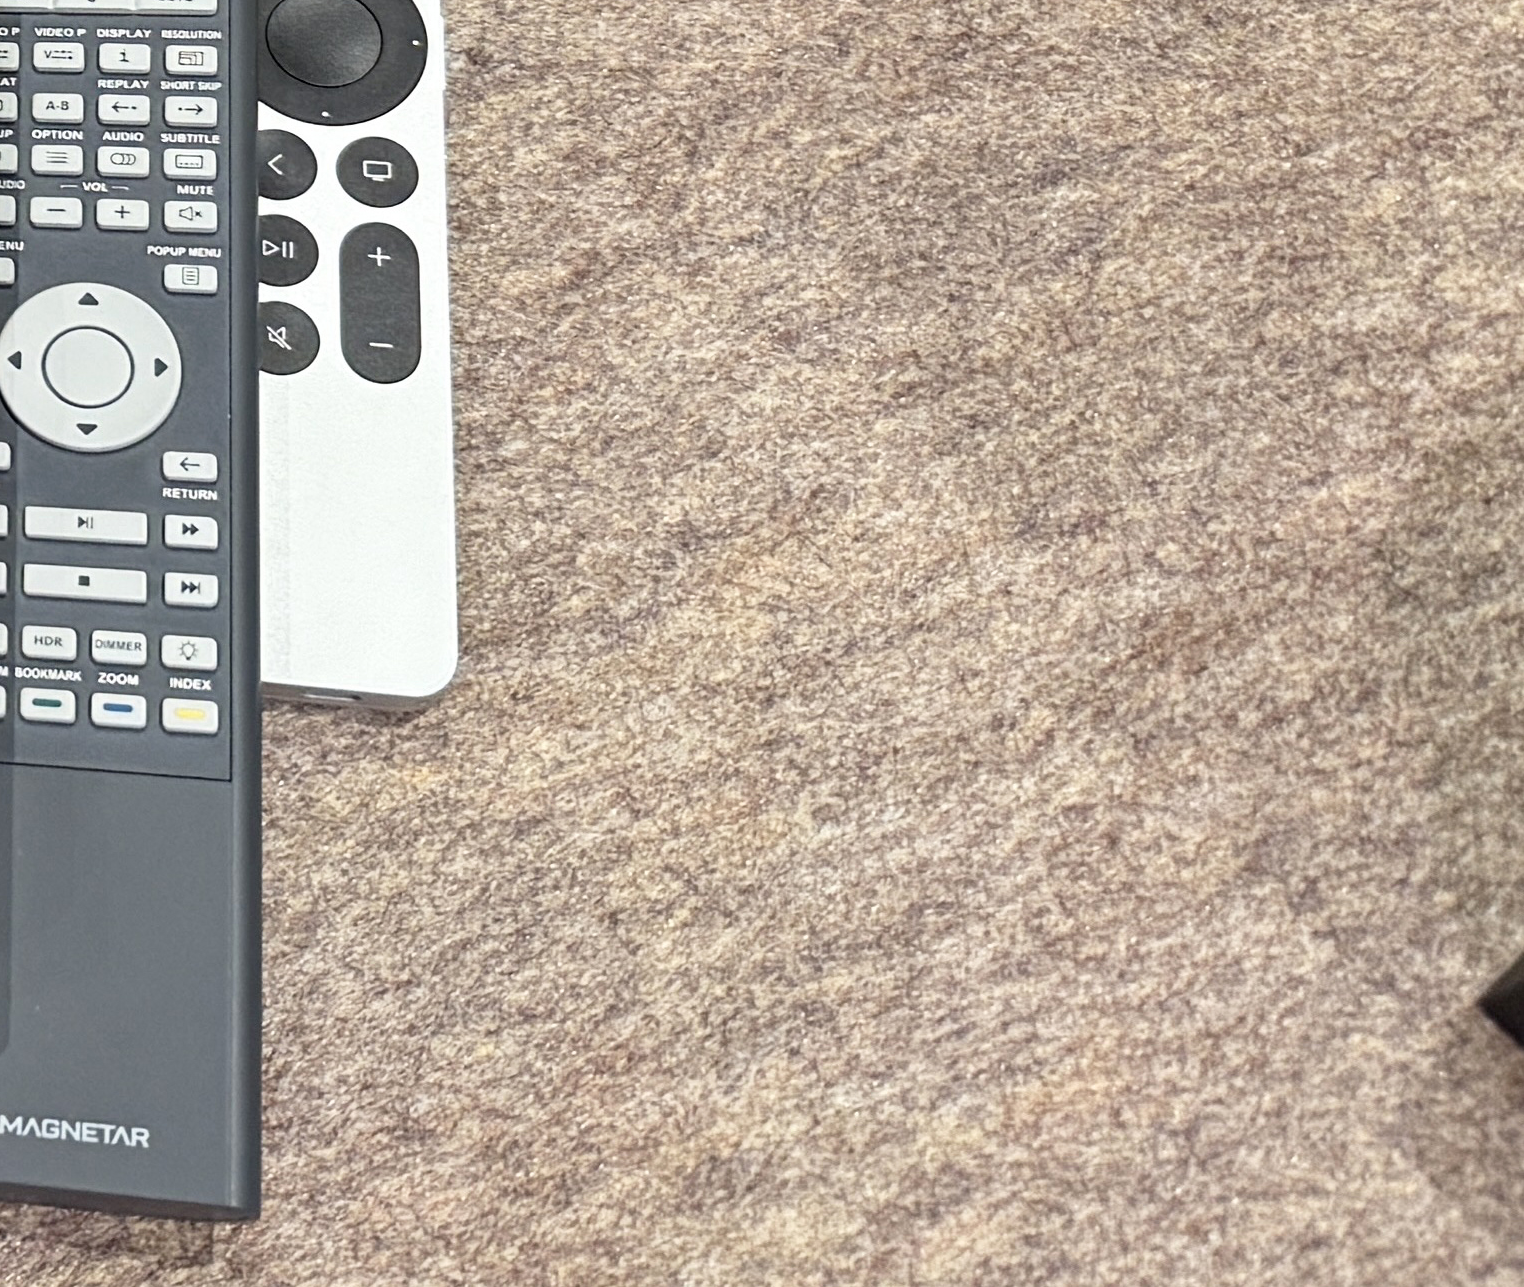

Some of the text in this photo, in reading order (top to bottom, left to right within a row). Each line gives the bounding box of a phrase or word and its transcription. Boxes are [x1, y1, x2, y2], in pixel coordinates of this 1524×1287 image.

[97, 29, 151, 39] DISPLAY
[97, 80, 150, 89] REPLAY
[32, 130, 83, 140] OPTION
[102, 132, 144, 142] AUDIO
[161, 133, 221, 144] SUBTITLE
[82, 182, 108, 192] VOL
[177, 185, 214, 195] MUTE
[162, 487, 218, 501] RETURN
[34, 636, 63, 648] HDR
[95, 640, 142, 651] DIMMER
[15, 668, 82, 682] BOOKMARK
[98, 672, 139, 686] ZOOM
[170, 678, 212, 691] INDEX
